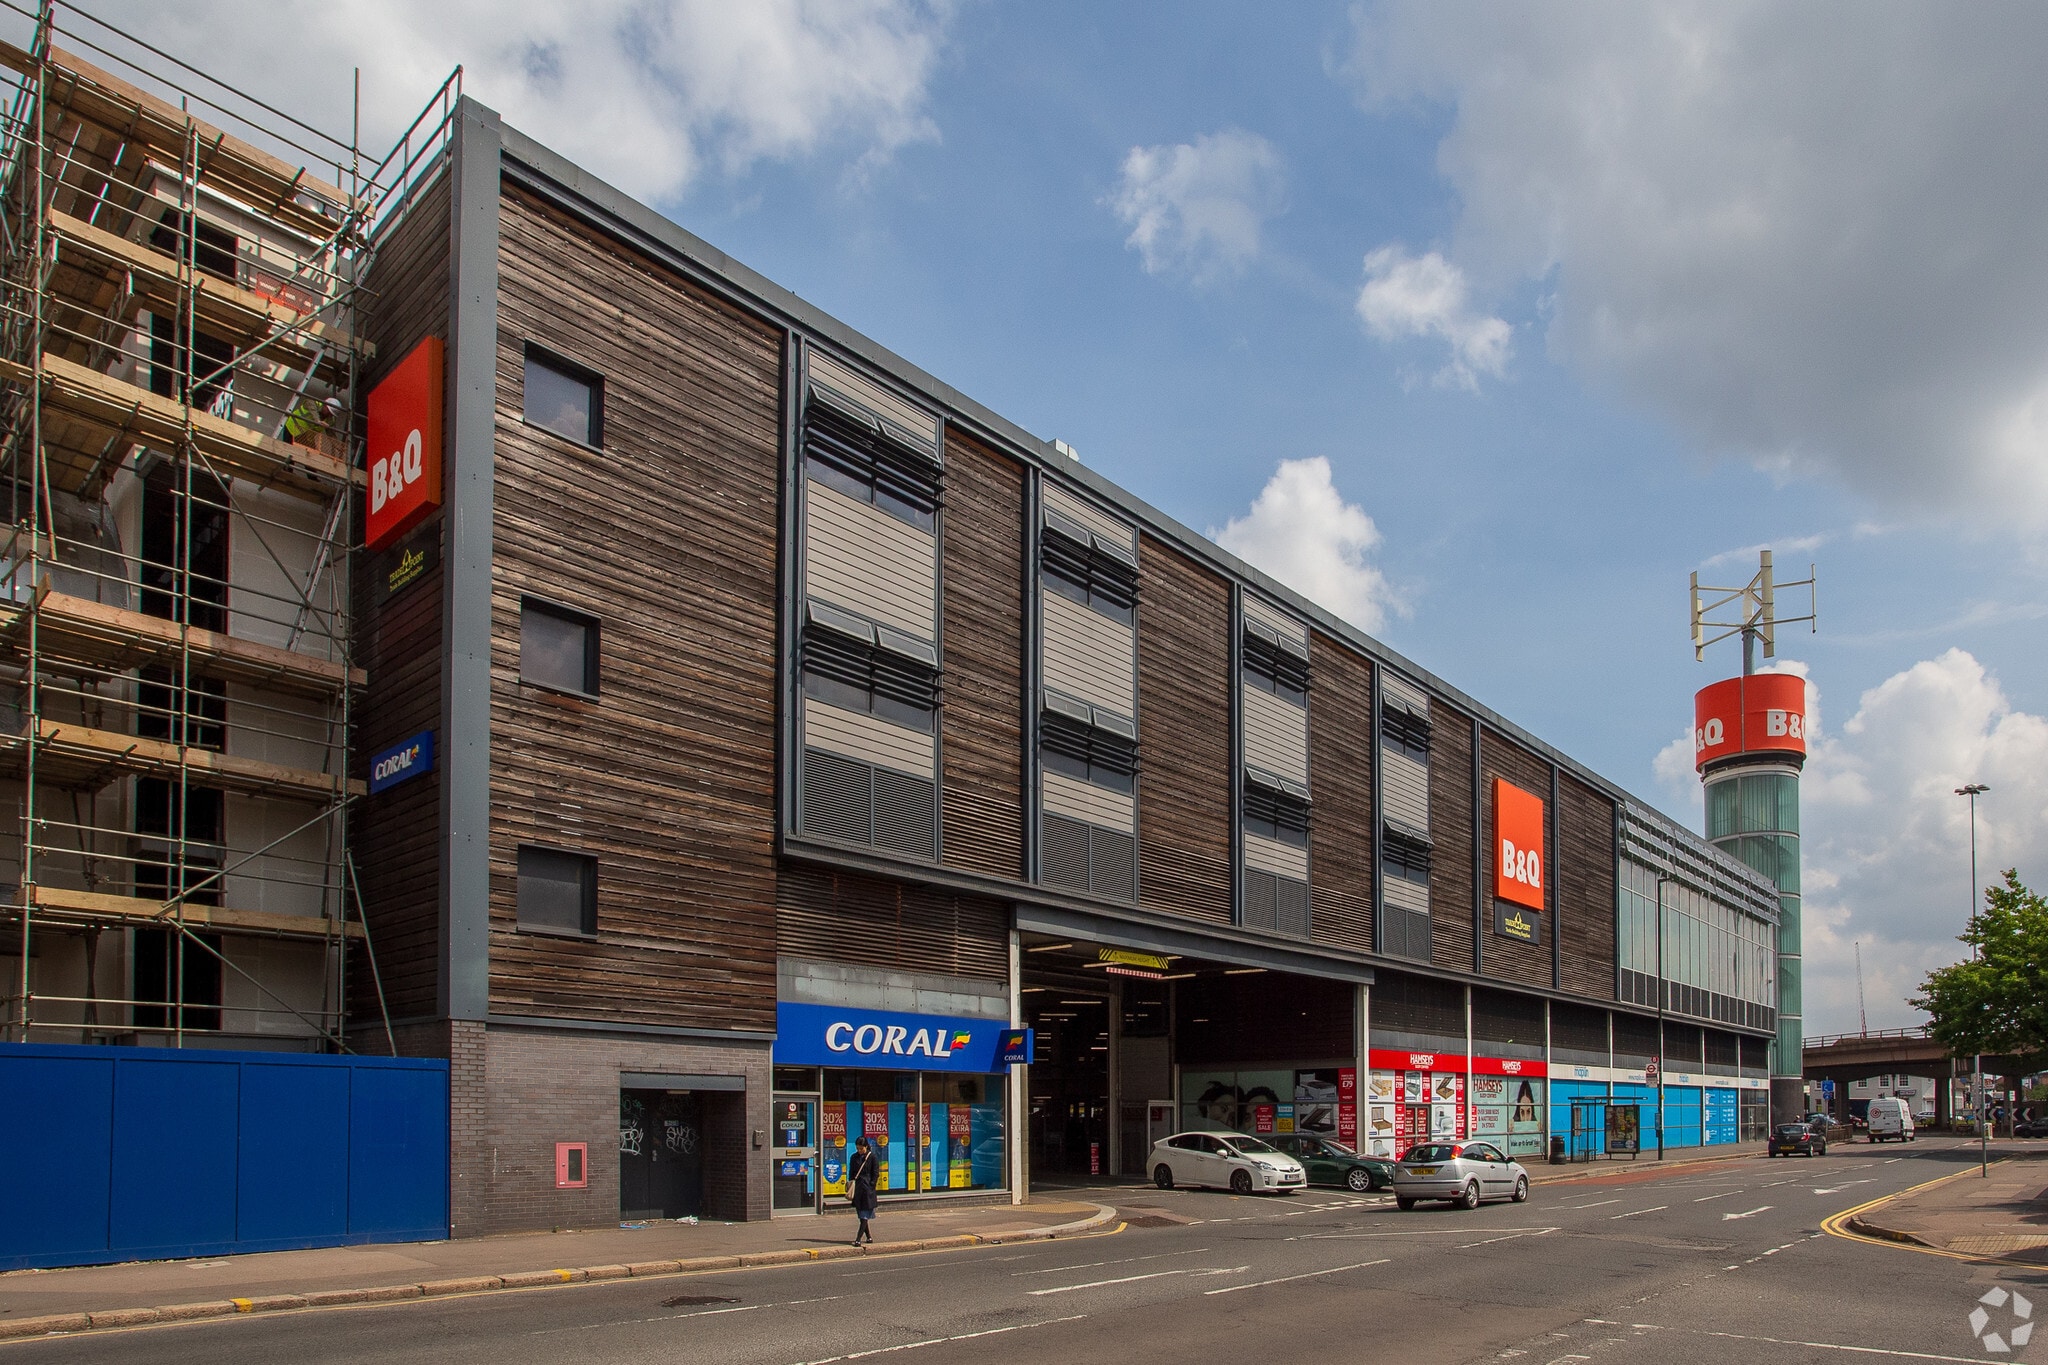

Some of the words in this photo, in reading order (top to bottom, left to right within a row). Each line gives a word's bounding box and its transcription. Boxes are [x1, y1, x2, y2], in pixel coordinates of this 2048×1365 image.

[371, 427, 423, 516] B&Q
[374, 746, 413, 781] CORAL
[1502, 838, 1541, 889] B&Q
[826, 1022, 951, 1058] CORAL
[1410, 1054, 1434, 1066] HAMSEYS
[1342, 1080, 1353, 1088] £79
[1473, 1079, 1502, 1093] HAMSEYS
[823, 1112, 843, 1123] 30%
[865, 1112, 886, 1124] 30%
[951, 1114, 969, 1124] 30%
[823, 1123, 845, 1132] EXTRA
[865, 1123, 888, 1132] EXTRA
[950, 1124, 970, 1132] EXTRA
